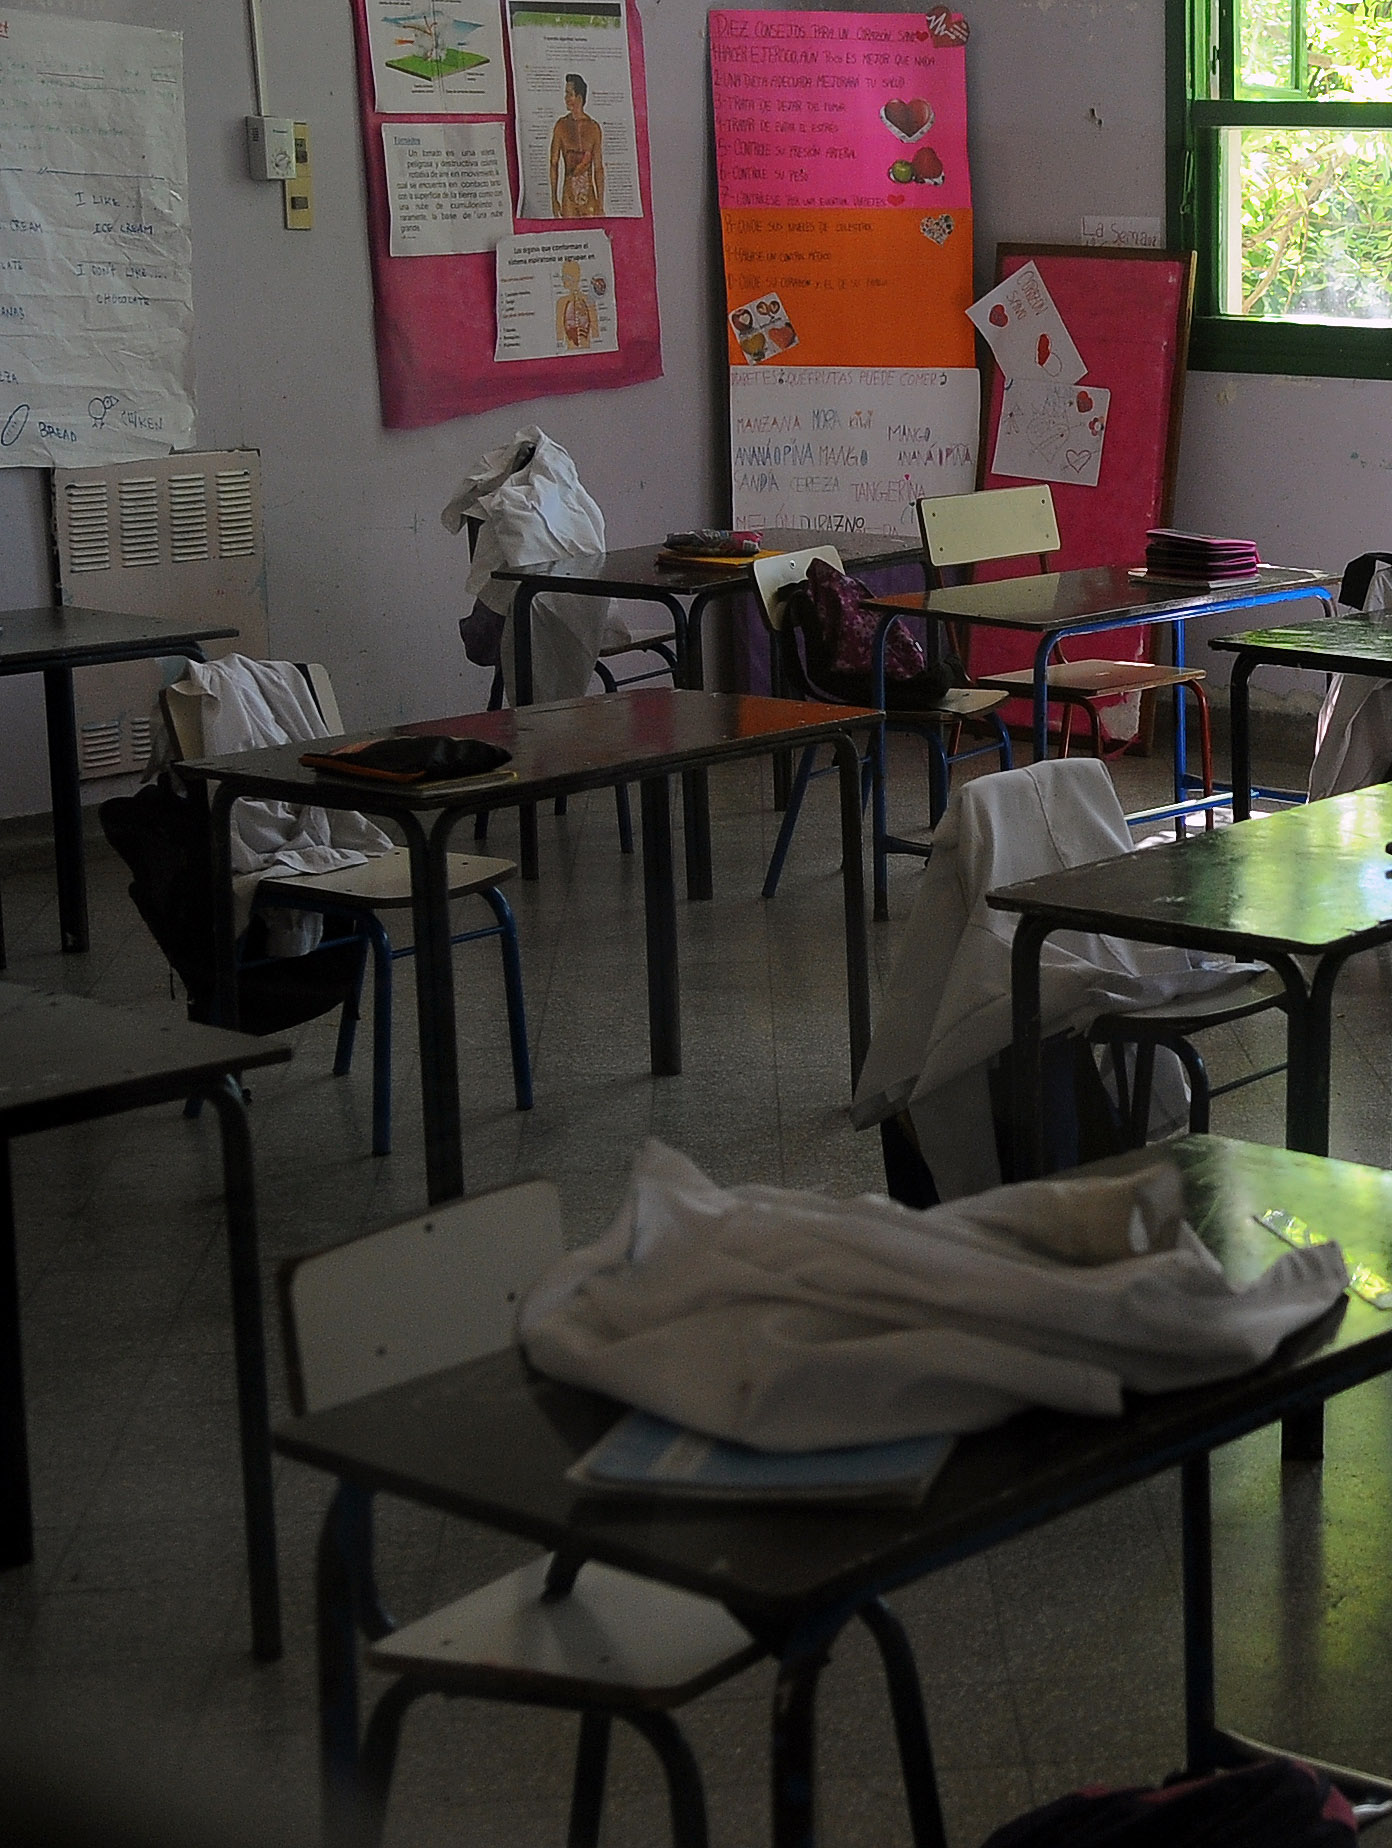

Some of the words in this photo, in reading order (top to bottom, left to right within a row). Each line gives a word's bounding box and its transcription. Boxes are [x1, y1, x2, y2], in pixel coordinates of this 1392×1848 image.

[714, 13, 748, 38] DIEZ
[755, 21, 805, 39] CONSEJOS
[839, 27, 849, 39] UN
[75, 192, 84, 207] I
[92, 194, 120, 207] LIKE
[93, 223, 113, 235] ICE
[120, 222, 152, 235] CREAM
[1082, 217, 1104, 238] La
[75, 264, 85, 276] I
[860, 370, 894, 386] PUEDE
[38, 421, 77, 442] BREAD
[737, 415, 801, 434] MANZANA
[887, 424, 931, 442] MANGO
[790, 476, 840, 493] CEREZA
